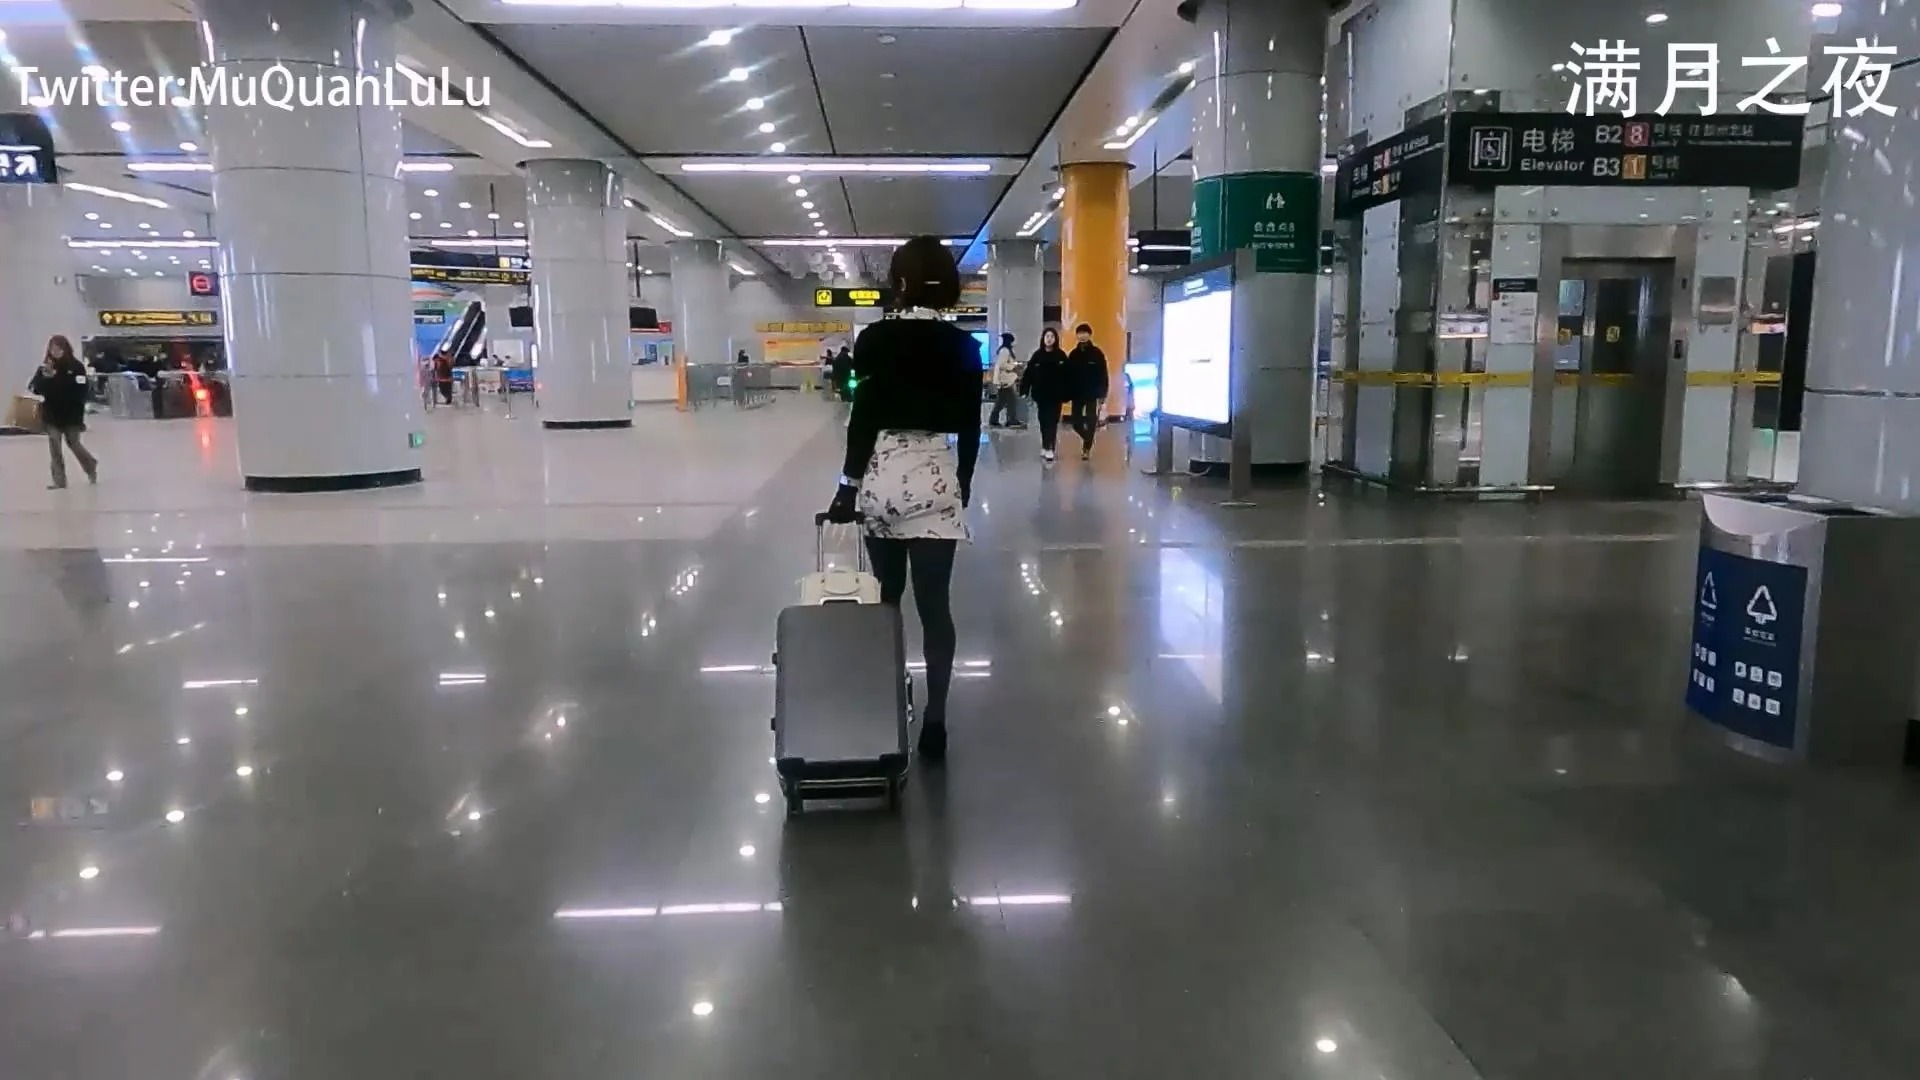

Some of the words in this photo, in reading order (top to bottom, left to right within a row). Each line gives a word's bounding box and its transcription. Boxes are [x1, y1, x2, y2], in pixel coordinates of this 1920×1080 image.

[1522, 127, 1576, 154] 电梯
[1595, 125, 1622, 144] B2
[1520, 158, 1585, 171] Elevator
[1592, 157, 1620, 176] B3
